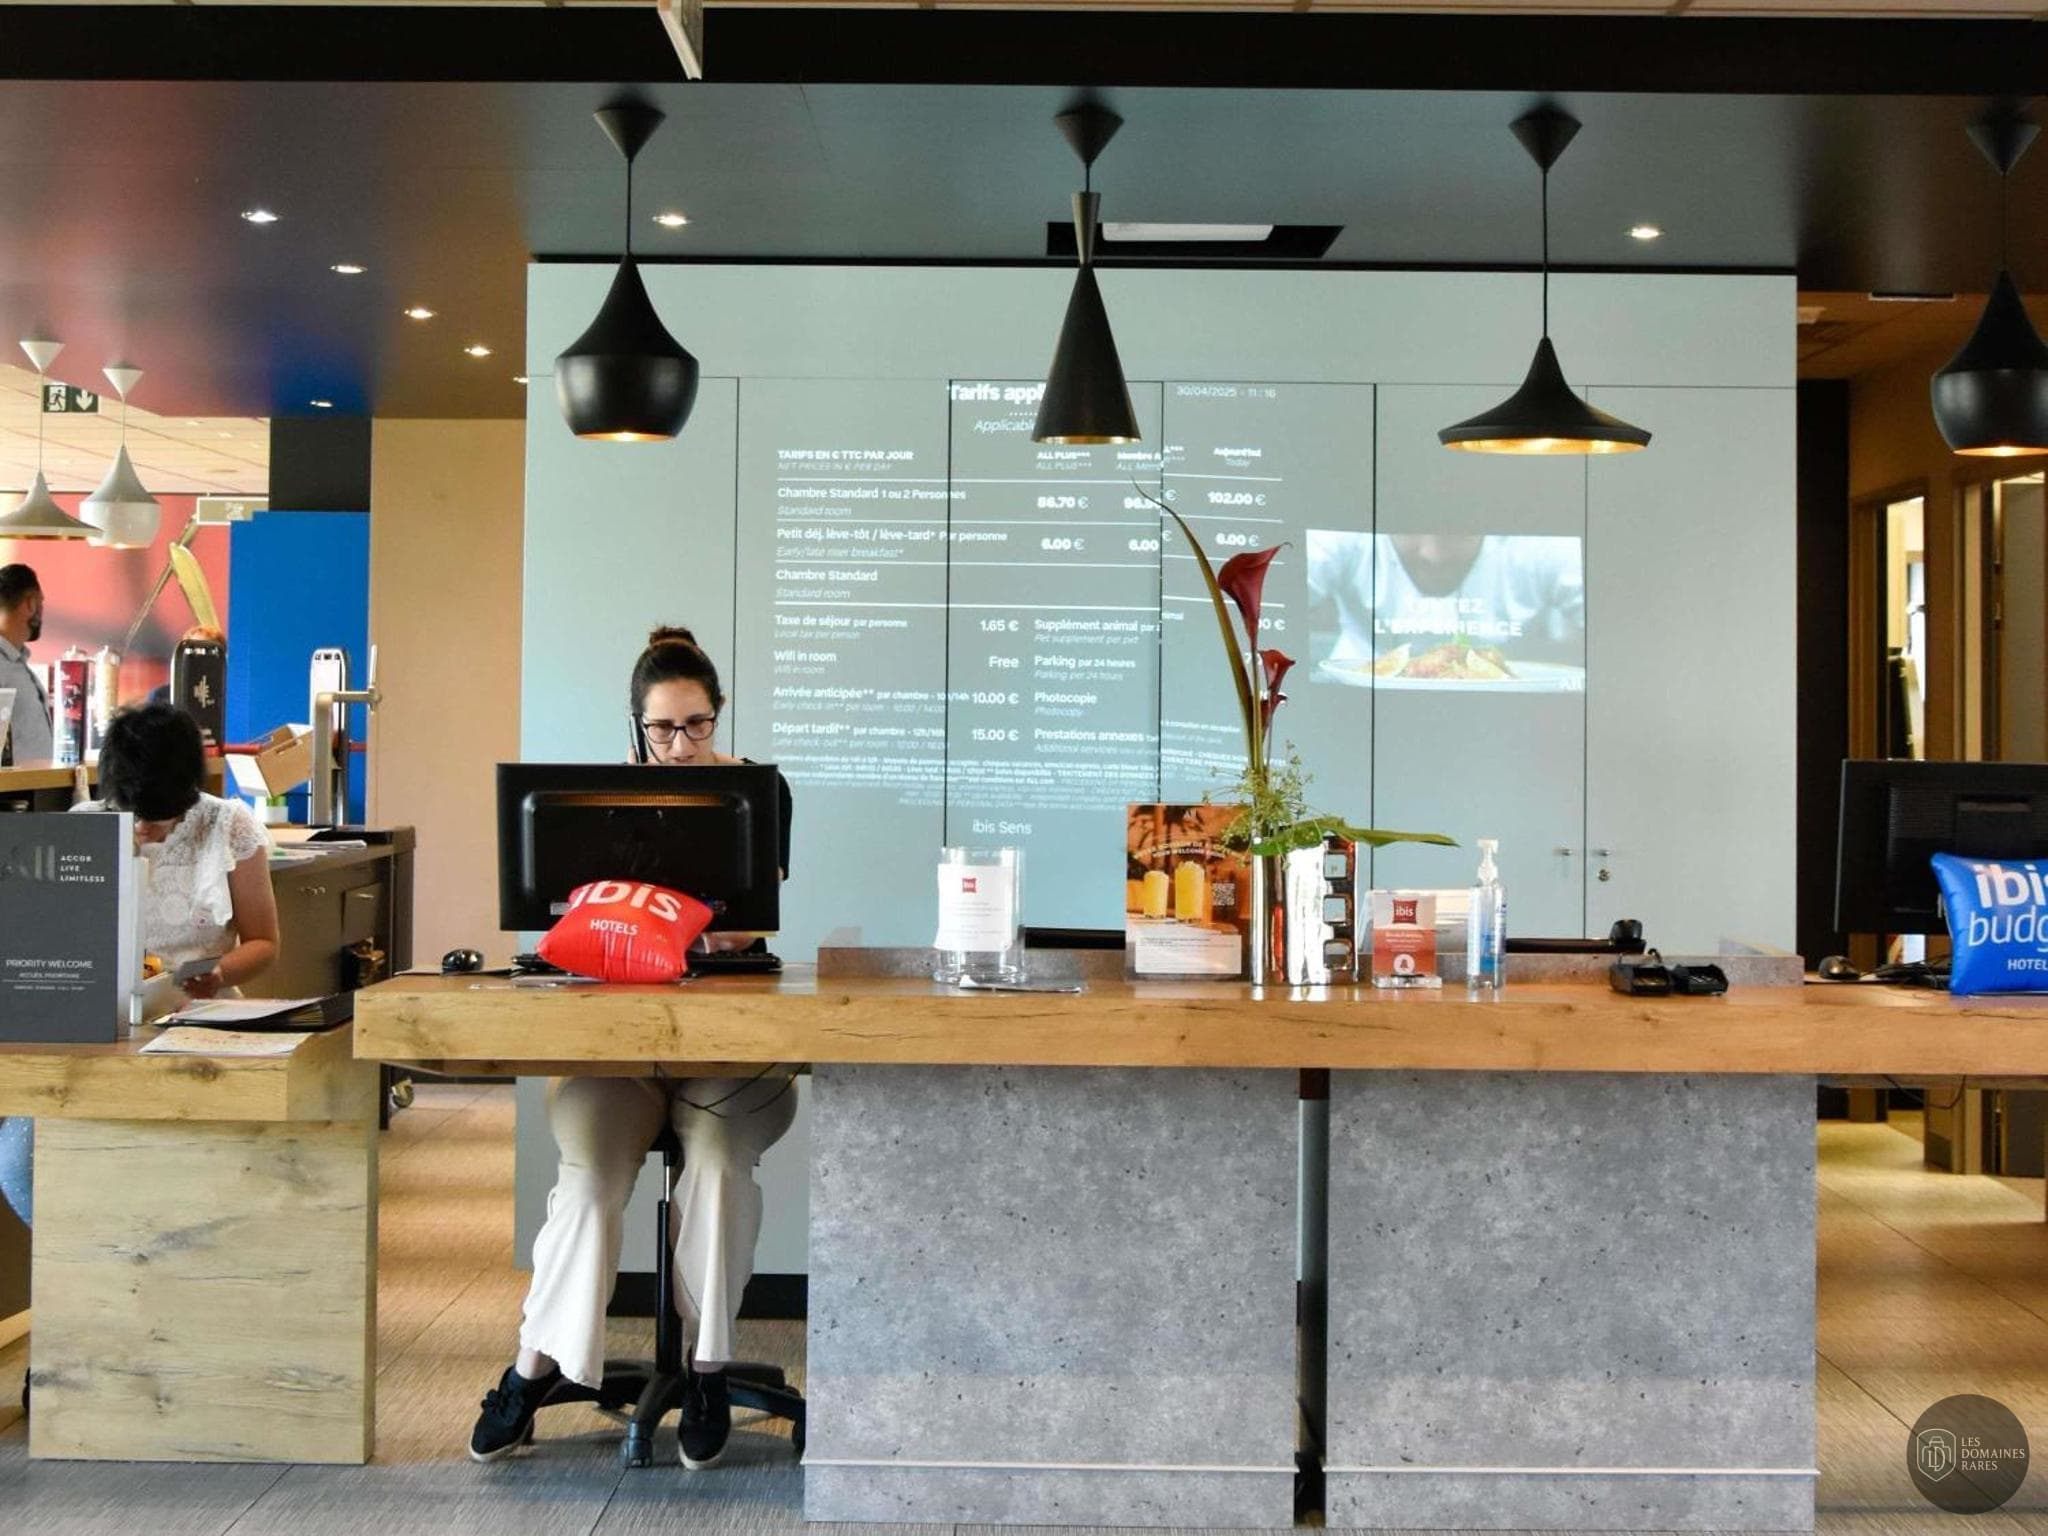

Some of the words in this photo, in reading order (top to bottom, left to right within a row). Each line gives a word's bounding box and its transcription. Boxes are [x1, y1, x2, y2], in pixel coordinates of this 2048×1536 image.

[947, 383, 1000, 401] Tarifs
[777, 450, 814, 460] TARIFS
[815, 450, 830, 460] EN
[841, 450, 863, 460] TTC
[864, 450, 885, 460] PAR
[886, 450, 914, 461] JOUR
[1037, 451, 1054, 460] ALL
[777, 487, 827, 499] Chambre
[829, 487, 879, 499] Standard
[888, 491, 902, 499] ou
[903, 489, 911, 499] 2
[1207, 491, 1253, 505] 102.00
[1255, 493, 1267, 506] €
[776, 528, 803, 540] Petit
[938, 532, 958, 542] Pr
[959, 533, 1008, 543] personne
[1041, 538, 1072, 550] 6.00
[1073, 538, 1085, 550] €
[1128, 539, 1159, 552] 6.00
[1215, 532, 1246, 546] 6.00
[1248, 534, 1259, 547] €
[775, 568, 826, 581] Chambre
[828, 569, 878, 581] Standard
[774, 614, 801, 626] Taxe
[802, 616, 817, 626] de
[818, 615, 852, 628] séjour
[980, 619, 1006, 632] 1.65
[1008, 619, 1019, 632] €
[1034, 619, 1100, 633] Supplément
[1102, 619, 1138, 632] animal
[773, 649, 795, 661] Wifi
[797, 650, 807, 661] in
[808, 652, 837, 662] room
[988, 656, 1019, 668] Free
[1034, 655, 1076, 670] Parking
[1078, 659, 1092, 669] par
[773, 686, 812, 698] Arrivée
[972, 692, 1006, 704] 10.00
[1008, 692, 1019, 704] €
[1034, 692, 1098, 706] Photocopie
[772, 722, 810, 736] Départ
[972, 728, 1006, 741] 15.00
[1008, 729, 1019, 741] €
[1034, 727, 1096, 741] Prestations
[1098, 729, 1144, 742] annexes
[972, 819, 996, 834] ibis
[1000, 820, 1032, 836] Sens
[60, 855, 92, 863] ACCOR
[60, 864, 80, 872] LIVE
[60, 874, 105, 883] LIMITLESS
[1396, 905, 1414, 917] ibis
[590, 919, 639, 936] HOTELS
[6, 959, 47, 969] PRIORITY
[48, 959, 93, 970] WELCOME
